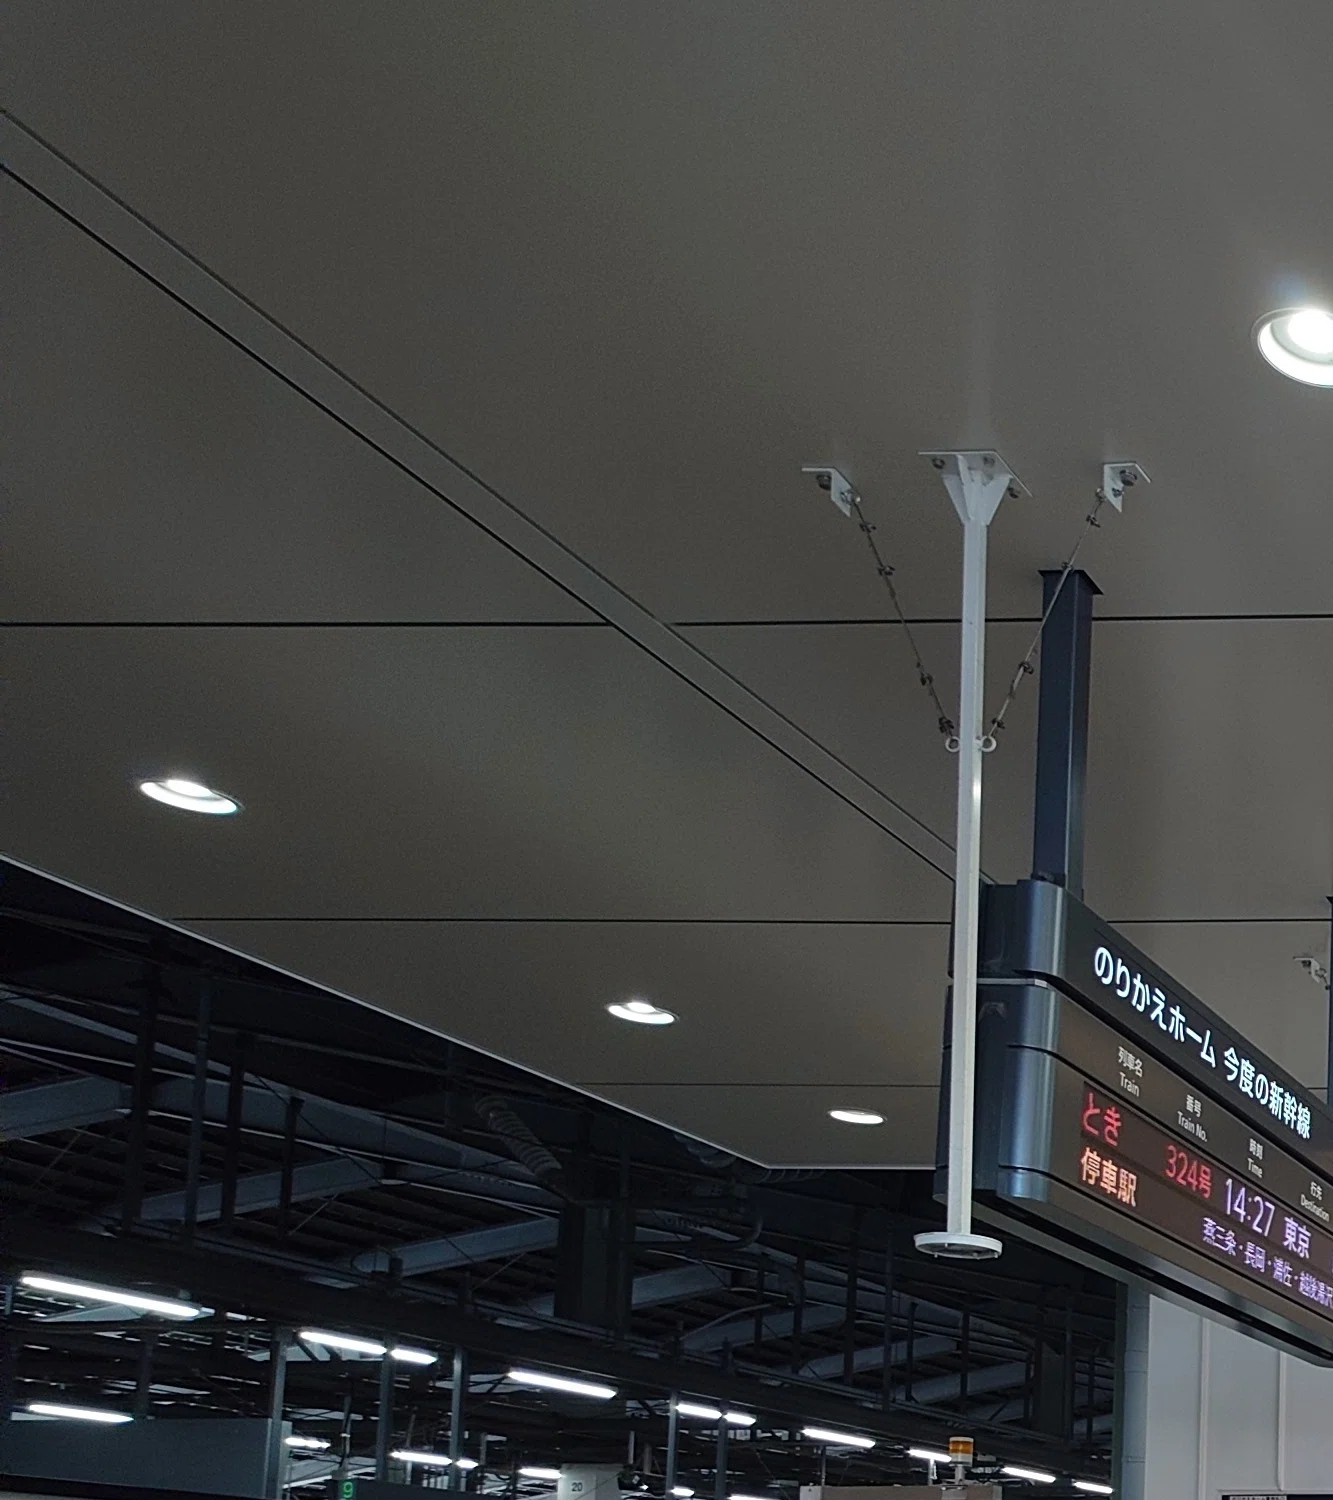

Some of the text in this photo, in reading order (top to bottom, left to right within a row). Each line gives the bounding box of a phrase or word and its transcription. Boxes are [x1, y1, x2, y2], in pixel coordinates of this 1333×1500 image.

[1094, 946, 1311, 1139] のりかえホーム 今度の新幹線
[1118, 1046, 1143, 1078] 列車名
[1119, 1072, 1140, 1097] Train
[1177, 1112, 1208, 1143] Train No.
[1081, 1092, 1122, 1147] とき
[1165, 1145, 1212, 1199] 324号
[1226, 1177, 1276, 1238] 14:27
[1284, 1216, 1312, 1260] 東京
[1081, 1147, 1137, 1208] 停車駅
[1248, 1158, 1263, 1179] Time
[1300, 1194, 1330, 1222] Destination
[342, 1480, 354, 1498] 9
[570, 1481, 583, 1493] 20
